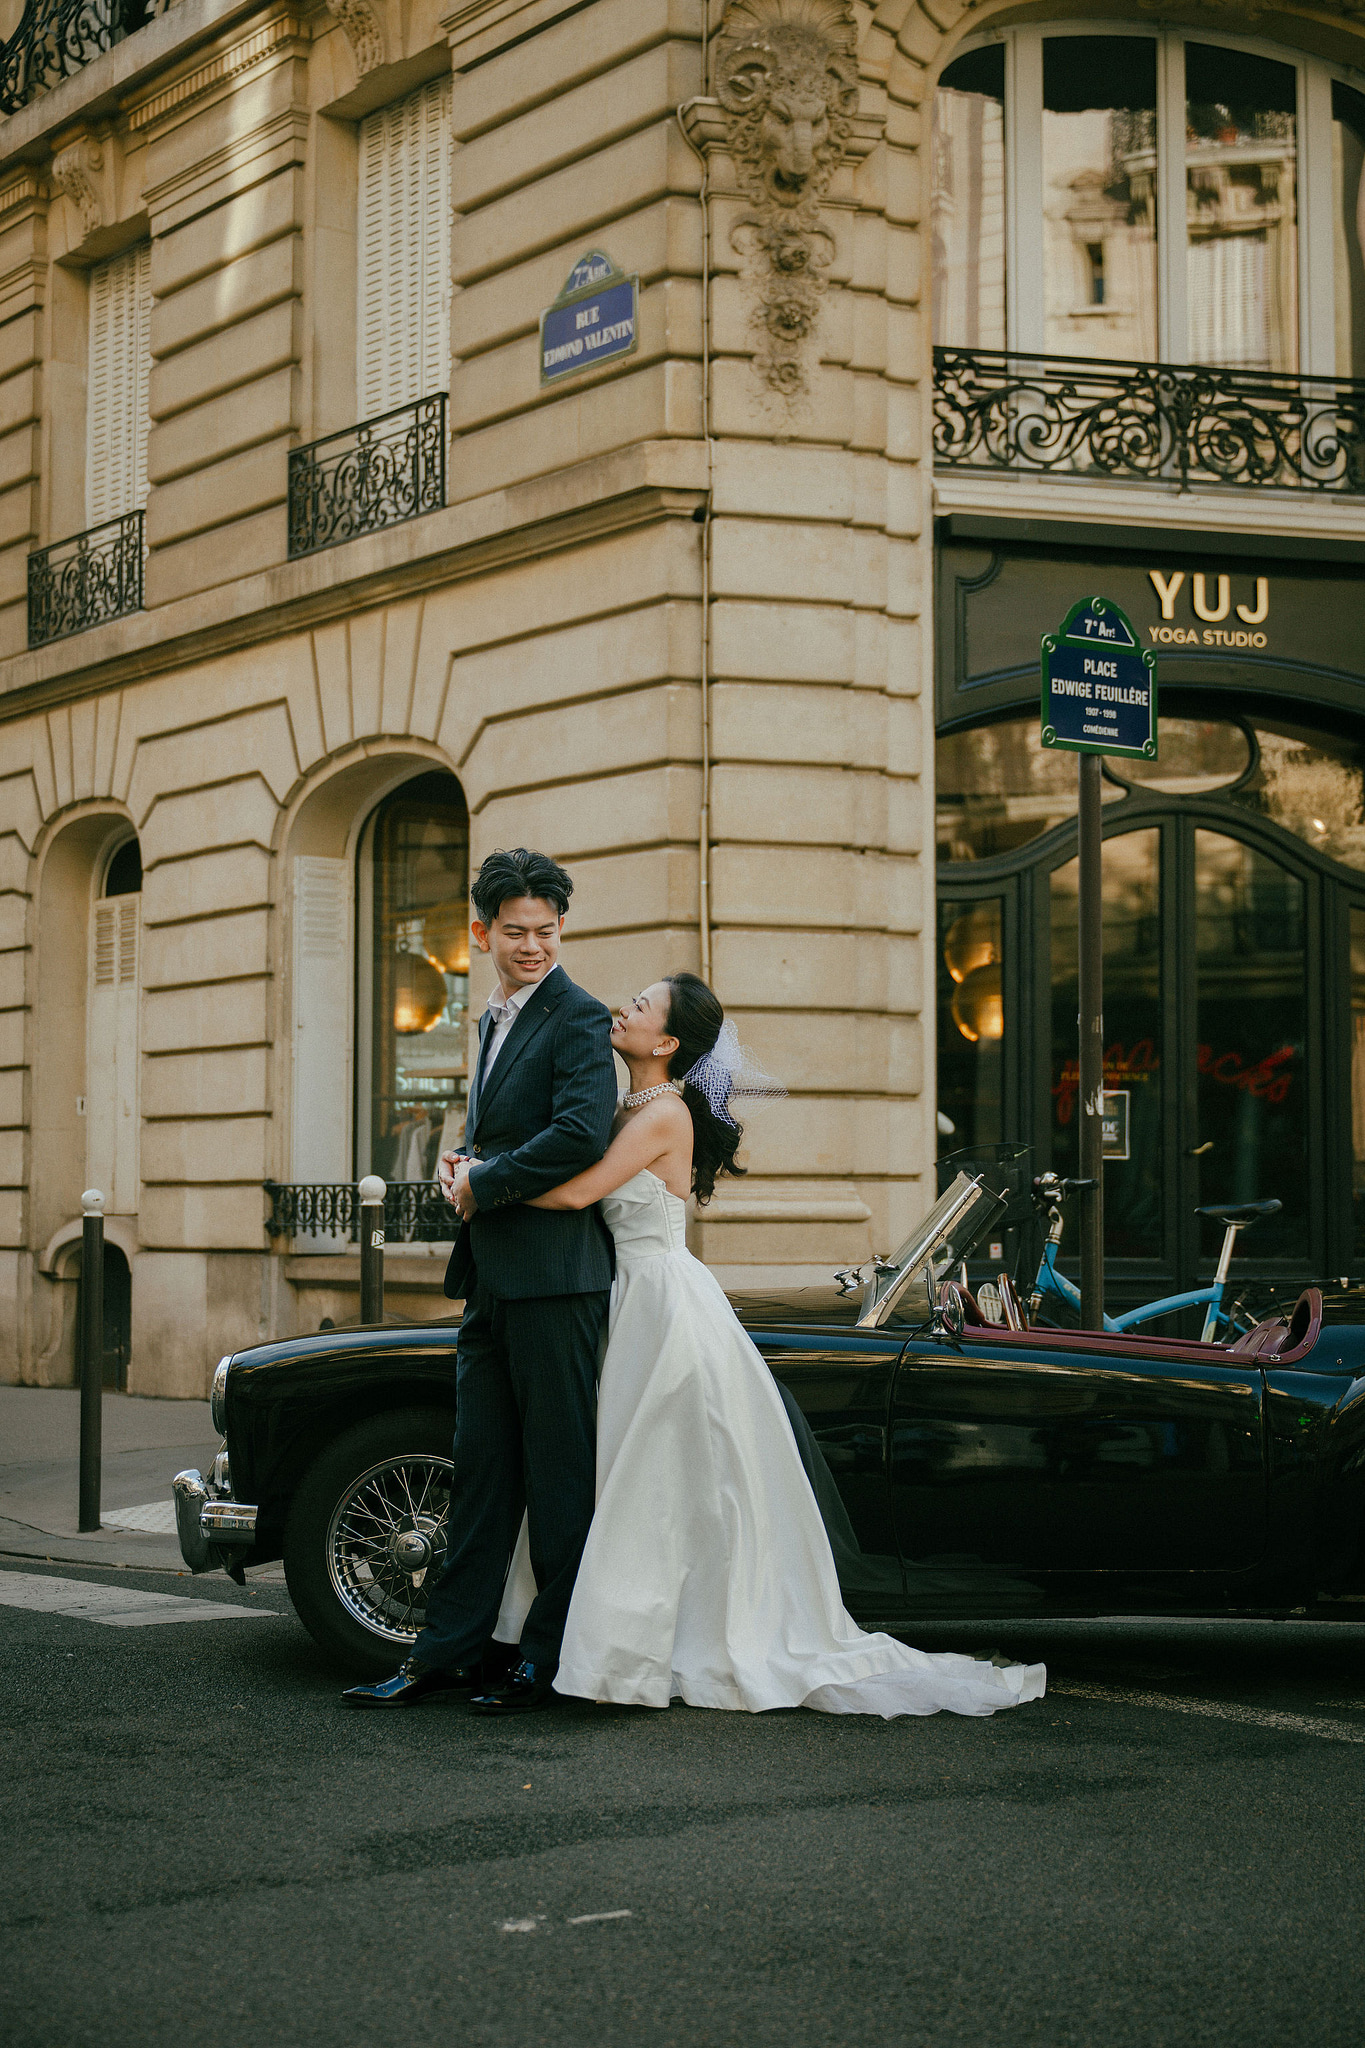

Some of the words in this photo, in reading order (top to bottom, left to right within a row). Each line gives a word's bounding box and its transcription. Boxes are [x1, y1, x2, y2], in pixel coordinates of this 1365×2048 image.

[575, 305, 600, 330] RUE
[543, 338, 584, 368] EDMOND
[584, 318, 634, 351] VALENTIN
[1149, 569, 1270, 625] YUJ
[1148, 625, 1200, 645] YOGA
[1202, 628, 1268, 648] STUDIO
[1084, 658, 1118, 679] PLACE
[1051, 677, 1093, 699] EDWIGE
[1095, 685, 1149, 707] FEUILLÈRE
[1082, 723, 1119, 737] COMÉDIENNE
